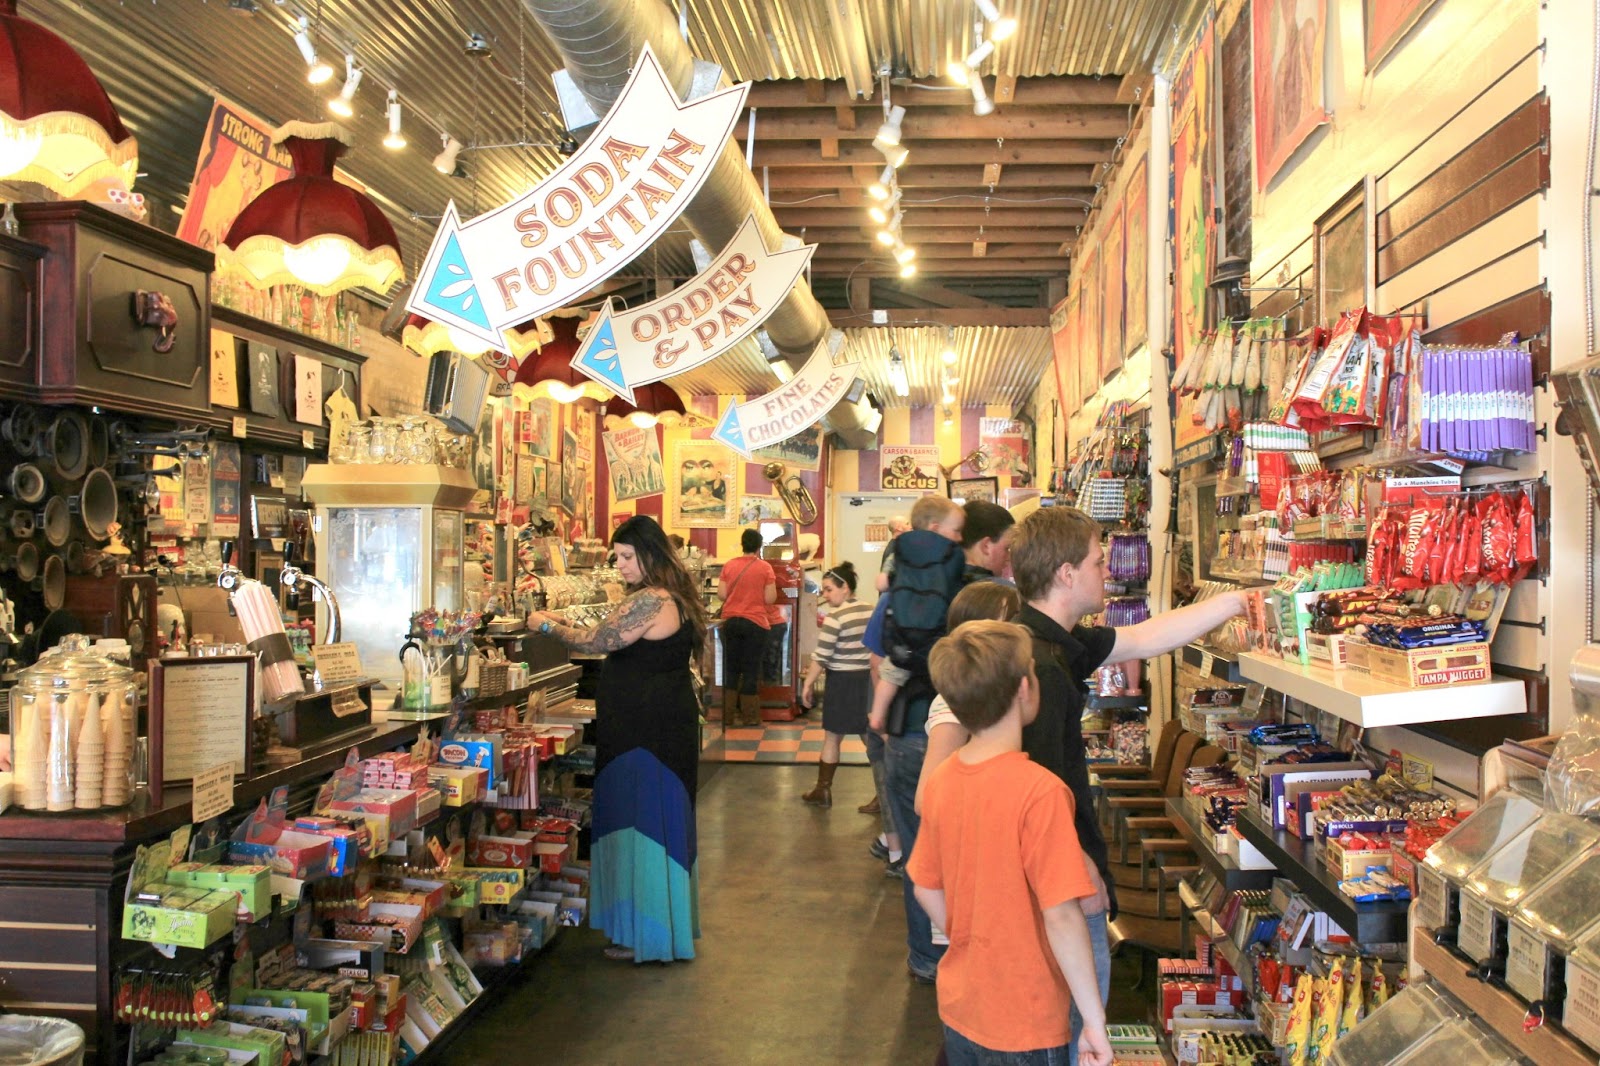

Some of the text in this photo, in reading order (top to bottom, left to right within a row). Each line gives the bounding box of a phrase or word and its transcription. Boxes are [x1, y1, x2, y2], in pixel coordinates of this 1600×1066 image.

[221, 112, 264, 154] STRONG
[514, 136, 649, 248] SODA
[492, 128, 705, 312] FOUNTAIN
[630, 252, 756, 343] ORDER
[651, 283, 762, 370] & PAY
[747, 373, 845, 444] CHOCOLATES
[762, 378, 813, 418] FINE
[623, 432, 646, 448] BAILEY
[883, 476, 938, 488] CIRCUS
[1405, 508, 1430, 575] Maltesers
[1422, 623, 1456, 632] ORIGINAL
[1420, 669, 1484, 685] TAMPA NUGGET
